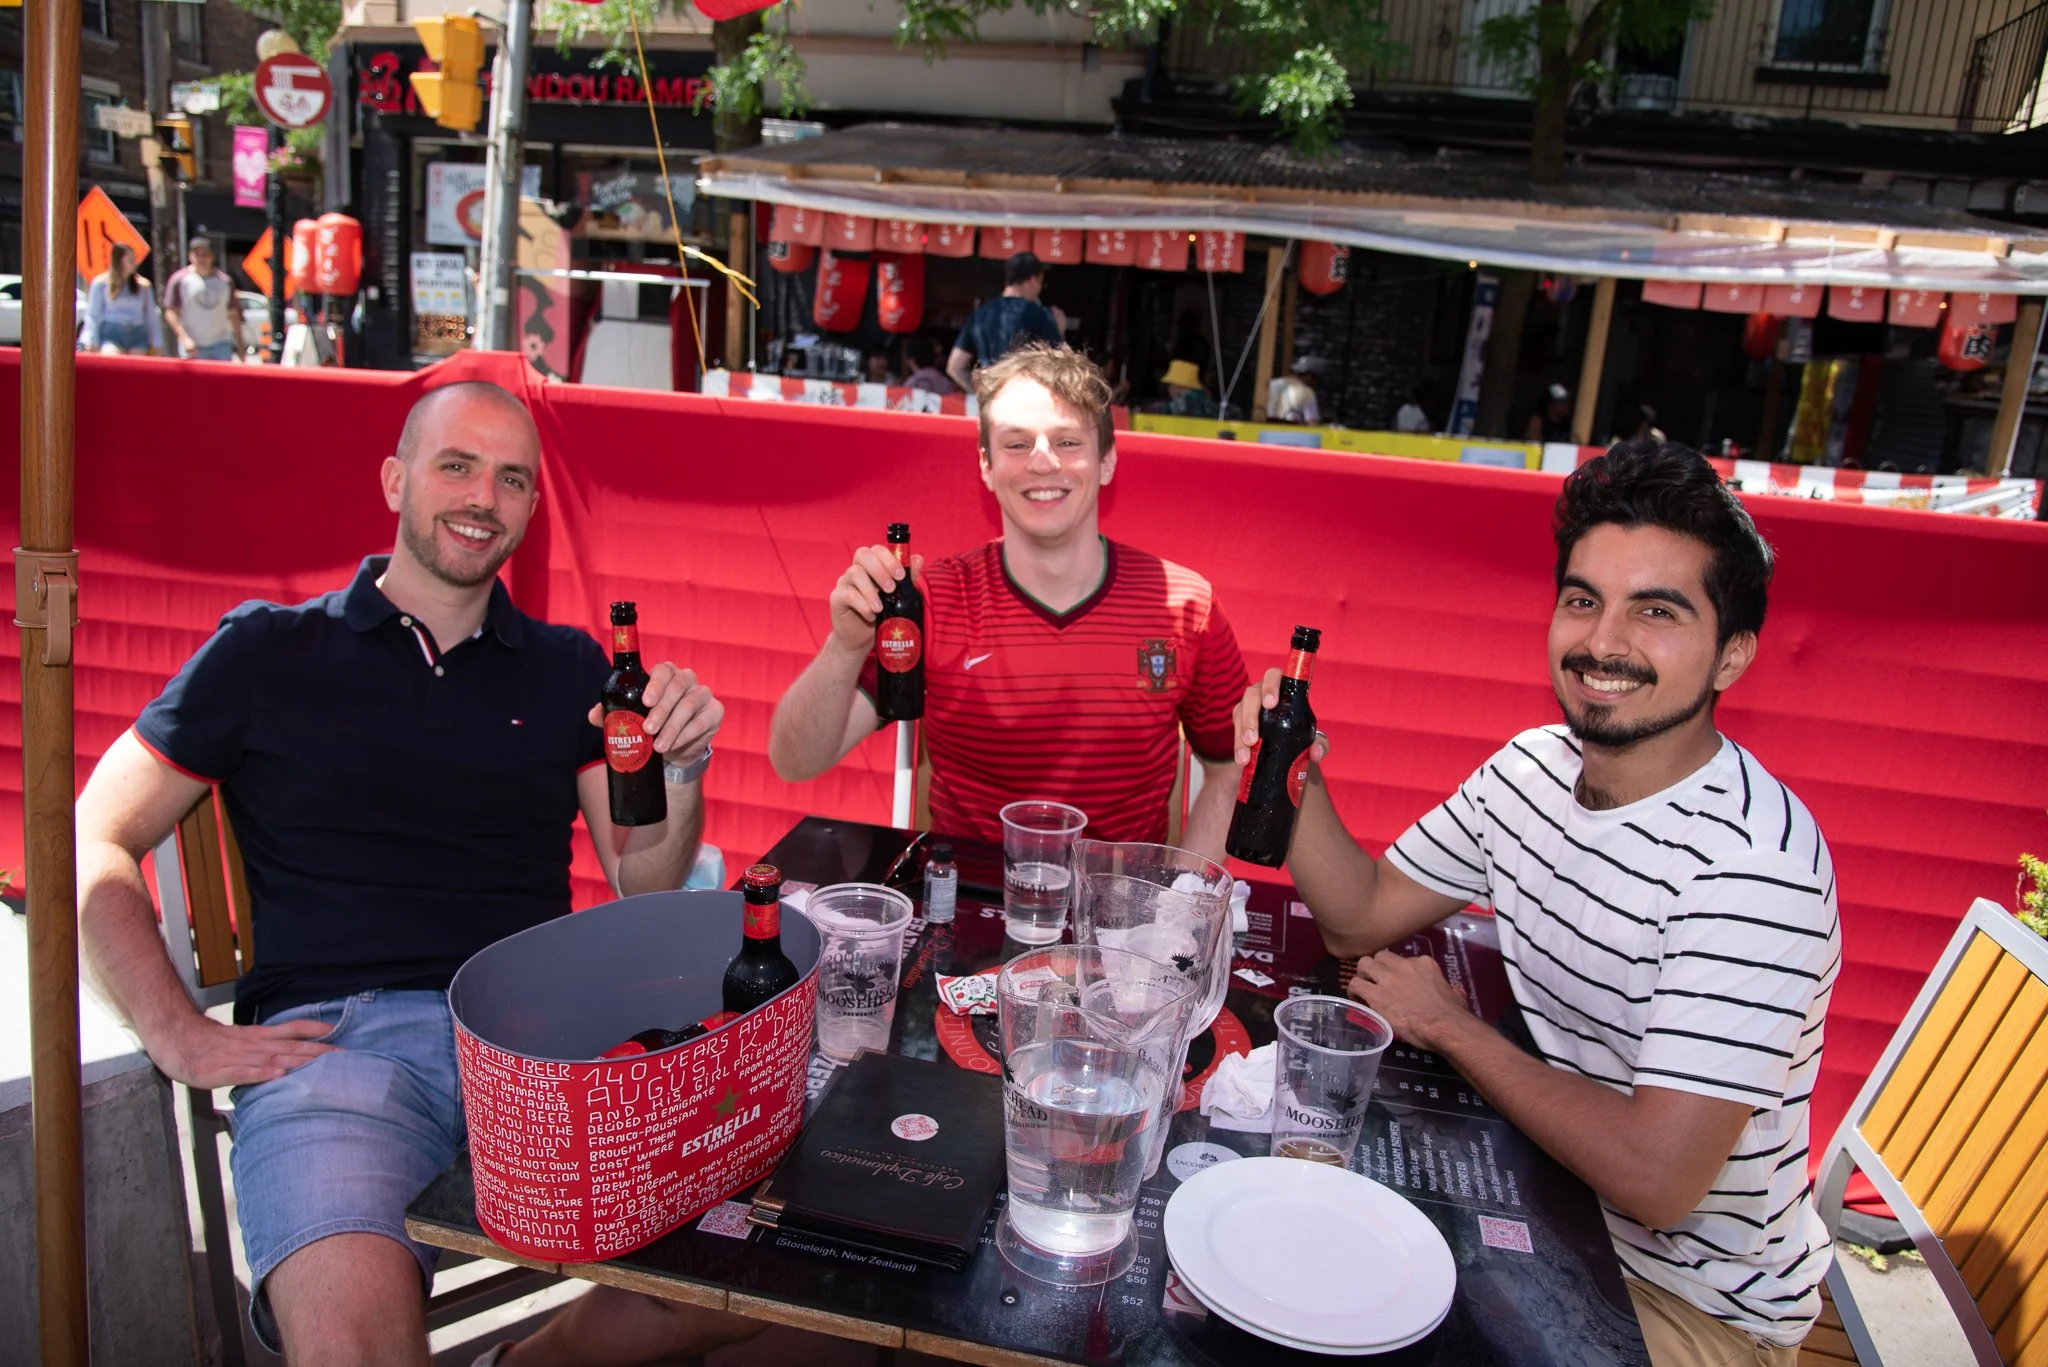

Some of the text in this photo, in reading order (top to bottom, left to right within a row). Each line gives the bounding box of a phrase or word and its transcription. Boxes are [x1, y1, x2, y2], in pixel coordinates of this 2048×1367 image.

[480, 72, 609, 103] TNDOU
[607, 735, 643, 745] ESTRELLA
[582, 1062, 647, 1087] 140
[660, 1032, 729, 1073] YEARS
[738, 1004, 778, 1039] AGO,
[781, 987, 802, 1011] THE
[478, 1042, 575, 1080] BETTER BEER.
[475, 1056, 511, 1081] SHOWN
[517, 1075, 560, 1092] THAT
[586, 1049, 727, 1107] AUGUST
[501, 1081, 566, 1103] DAMAGES
[643, 1111, 658, 1123] TO
[738, 1060, 764, 1080] FROM
[496, 1101, 523, 1118] OUR
[526, 1109, 572, 1125] BEER
[514, 1096, 574, 1113] FLAVOUR.
[589, 1105, 635, 1124] AND
[496, 1113, 523, 1131] YOU
[547, 1124, 575, 1136] THE
[589, 1141, 644, 1162] BROUGHT
[648, 1130, 677, 1147] THEM
[748, 1085, 759, 1096] TO
[589, 1074, 790, 1173] COAST WHERE THEY
[681, 1104, 761, 1159] ESTRELLA
[1389, 1120, 1402, 1147] BREWERY
[527, 1147, 560, 1160] OUR
[707, 1132, 736, 1154] DAMM
[483, 1156, 507, 1174] MORE
[522, 1159, 547, 1171] NOT
[548, 1160, 579, 1171] ONLY
[630, 1161, 651, 1174] THE
[820, 1149, 917, 1182] Diplomatico
[1409, 1147, 1420, 1164] Lager
[1423, 1132, 1438, 1192] Natural Blonde Lager
[663, 1172, 696, 1197] WHEN
[699, 1157, 724, 1176] THEY
[1443, 1149, 1454, 1194] Boneshaker IPA
[1456, 1162, 1472, 1198] IMPORTED
[1469, 1140, 1487, 1200] Estrella Damm Lager
[1488, 1166, 1501, 1184] Damm
[594, 1219, 627, 1233] OWN
[639, 1180, 702, 1220] BREWERY
[706, 1168, 728, 1185] AND
[730, 1141, 772, 1170] CREATED
[772, 1135, 780, 1145] A
[636, 1170, 680, 1195] DREAM
[1493, 1184, 1504, 1203] Inedit
[1503, 1170, 1521, 1206] Birra Peroni
[507, 1191, 526, 1203] THE
[555, 1197, 583, 1208] PURE
[595, 1165, 746, 1244] ADAPTED TO THE HOT
[540, 1209, 580, 1221] TASTE
[1136, 1219, 1157, 1229] $50
[1138, 1207, 1159, 1218] $50
[496, 1223, 520, 1242] OPEN
[522, 1235, 531, 1245] A
[533, 1237, 585, 1251] BOTTLE.
[509, 1214, 577, 1238] DAMM
[841, 1249, 868, 1263] New
[1136, 1255, 1151, 1265] 50
[1125, 1274, 1147, 1285] $50
[1128, 1264, 1149, 1275] $50
[1121, 1295, 1144, 1306] $52
